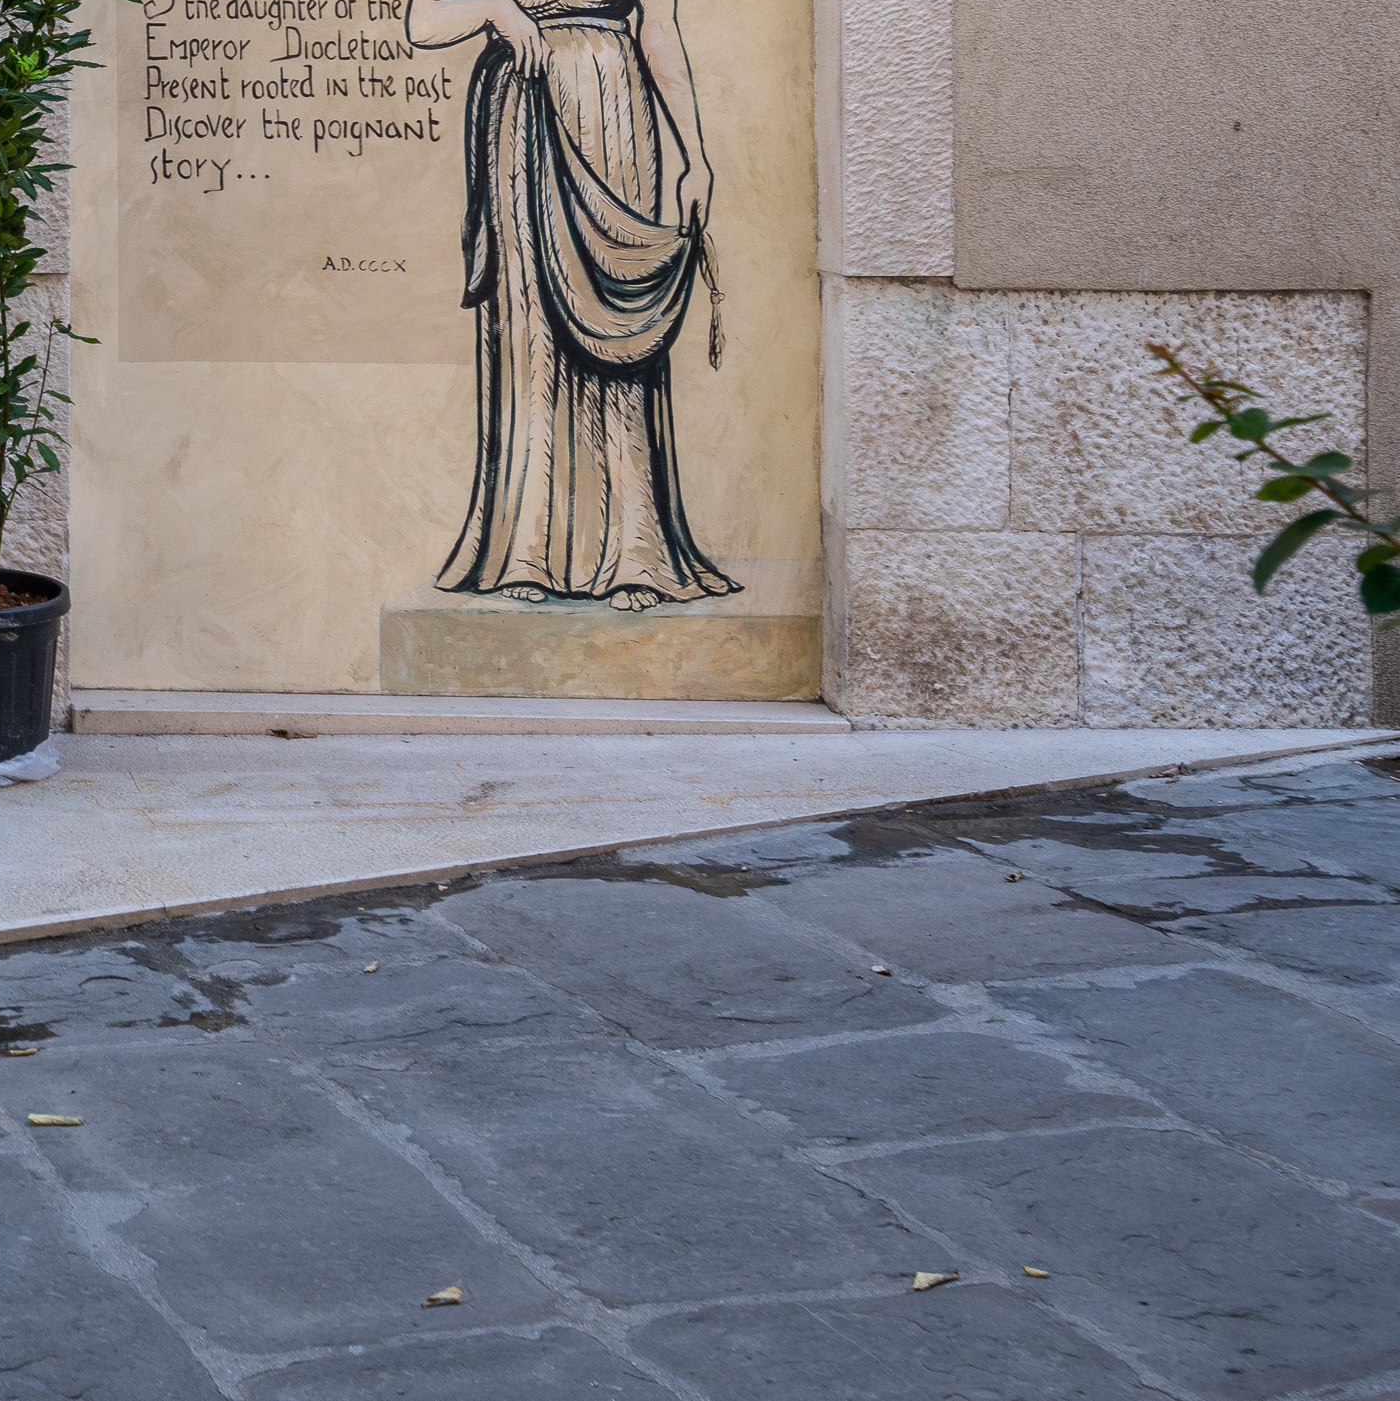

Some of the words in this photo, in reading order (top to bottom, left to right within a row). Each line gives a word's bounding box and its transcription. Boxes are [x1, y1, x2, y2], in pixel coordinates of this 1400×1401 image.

[146, 22, 251, 68] Emperor
[144, 65, 231, 103] Present
[241, 64, 315, 100] rooted
[358, 66, 397, 99] the
[405, 67, 453, 103] past
[144, 106, 247, 145] Discover
[262, 108, 303, 141] the
[313, 108, 442, 157] poignant
[150, 148, 271, 194] story...
